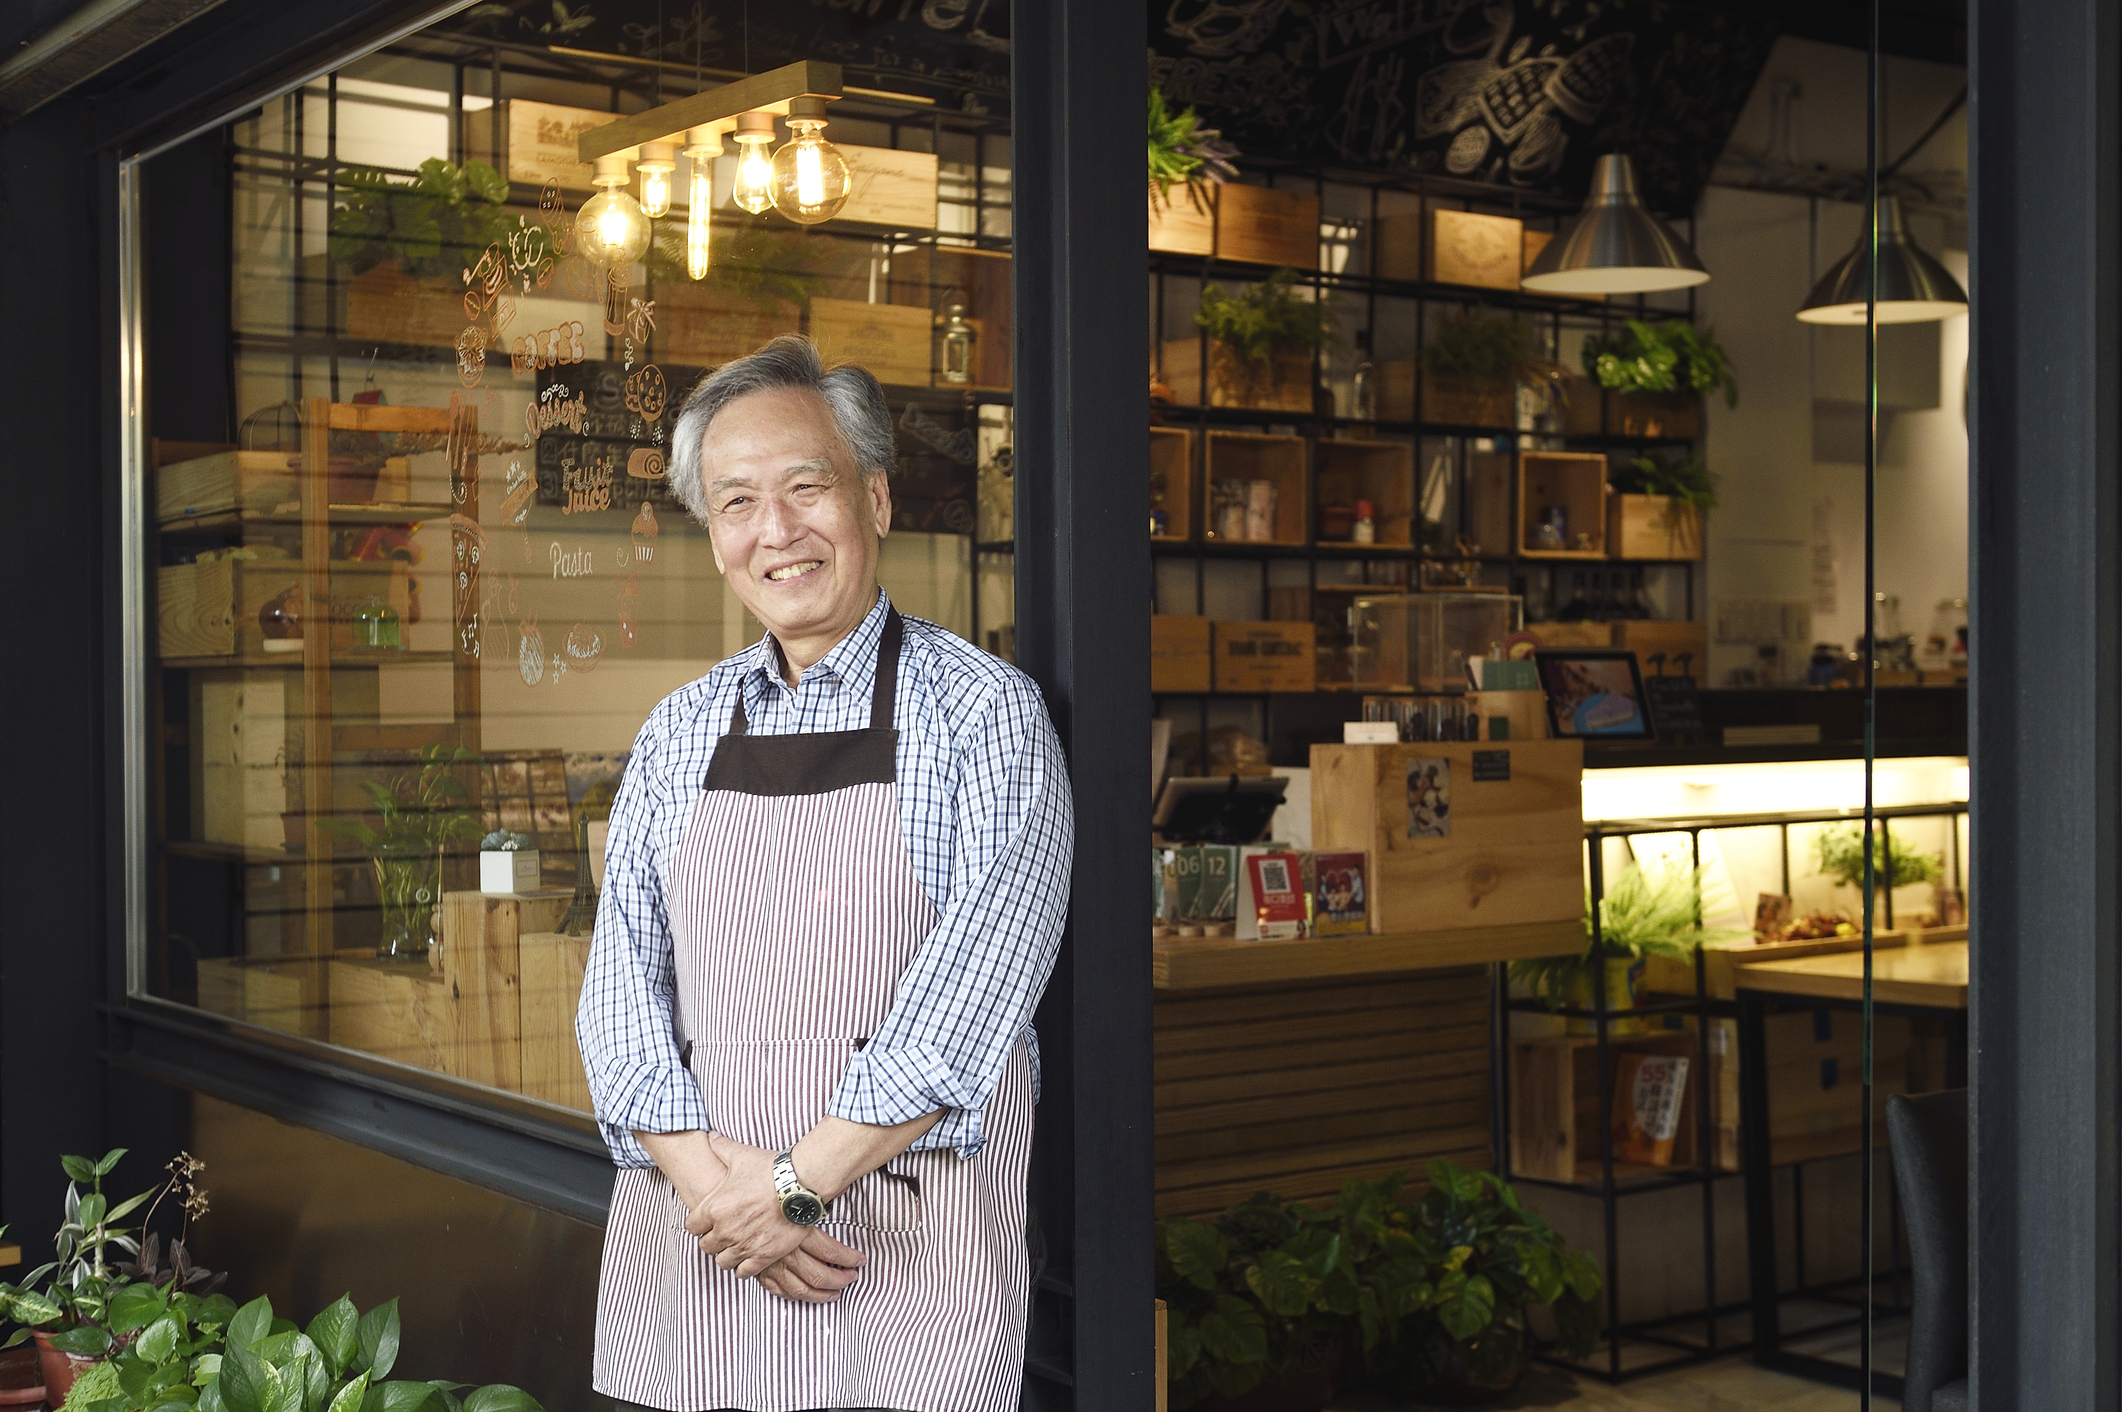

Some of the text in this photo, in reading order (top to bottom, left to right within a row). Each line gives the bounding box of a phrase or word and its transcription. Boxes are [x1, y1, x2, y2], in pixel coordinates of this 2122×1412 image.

[511, 320, 585, 376] COFFEE
[525, 390, 588, 440] Dessert
[560, 456, 614, 491] Fruit
[549, 541, 594, 580] Pasta
[1208, 857, 1226, 875] 12
